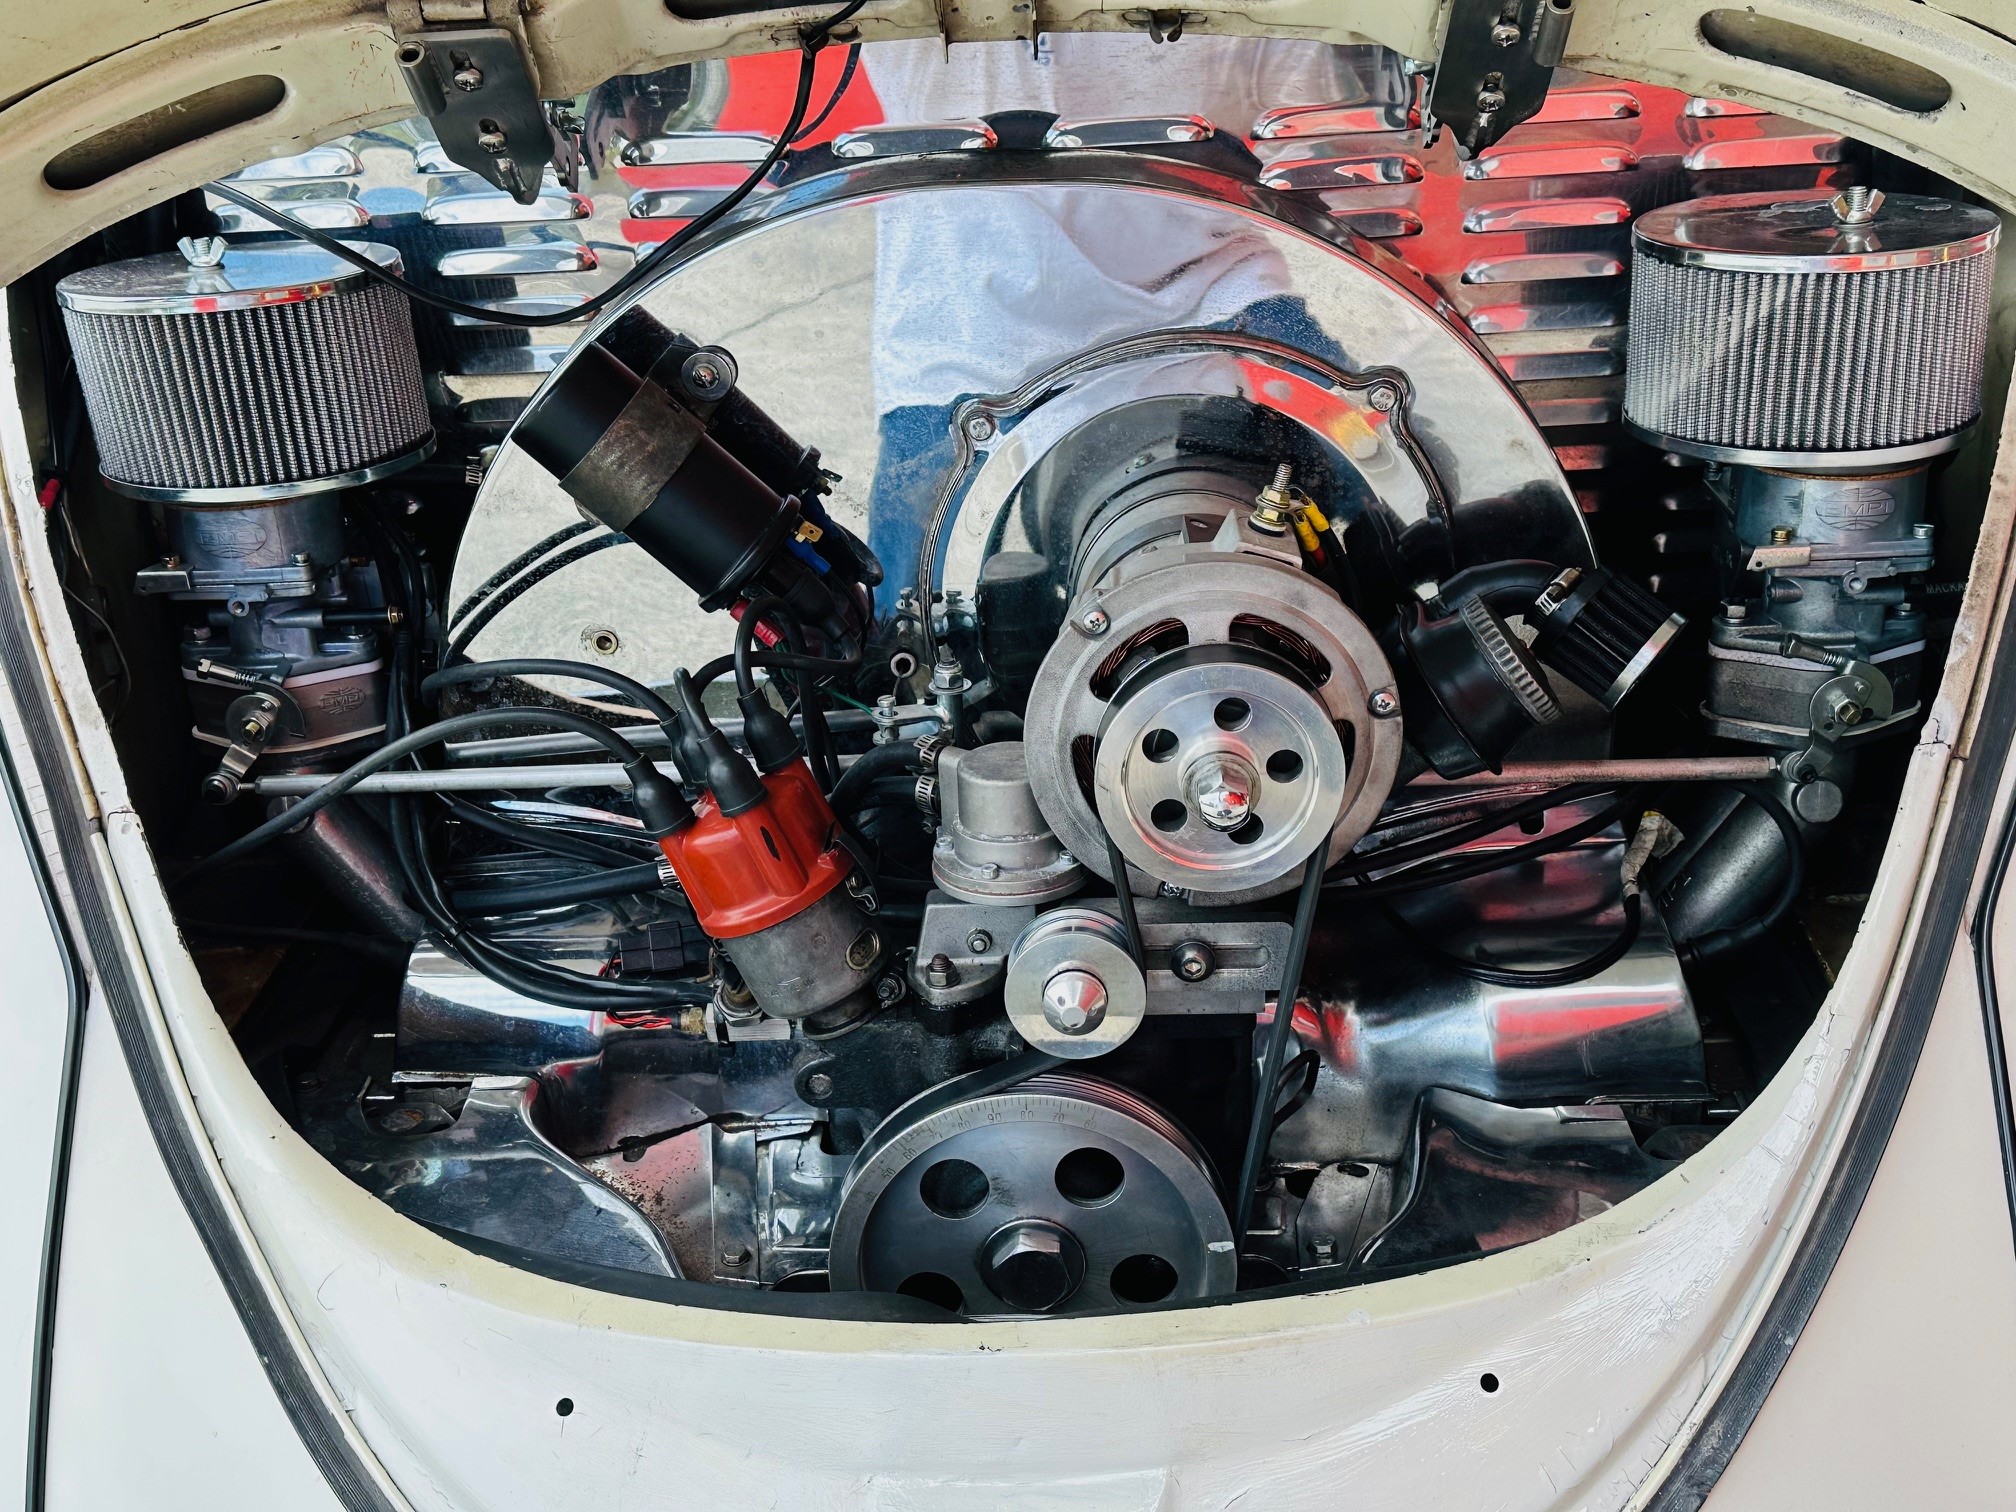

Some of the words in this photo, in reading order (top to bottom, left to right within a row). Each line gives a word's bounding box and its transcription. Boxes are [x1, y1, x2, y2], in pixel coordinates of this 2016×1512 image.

[1825, 501, 1890, 515] EMPI
[1924, 582, 1967, 595] MACKA
[902, 1148, 918, 1161] 60
[986, 1112, 1003, 1124] 90
[1020, 1110, 1034, 1121] 80
[1052, 1112, 1065, 1123] 70
